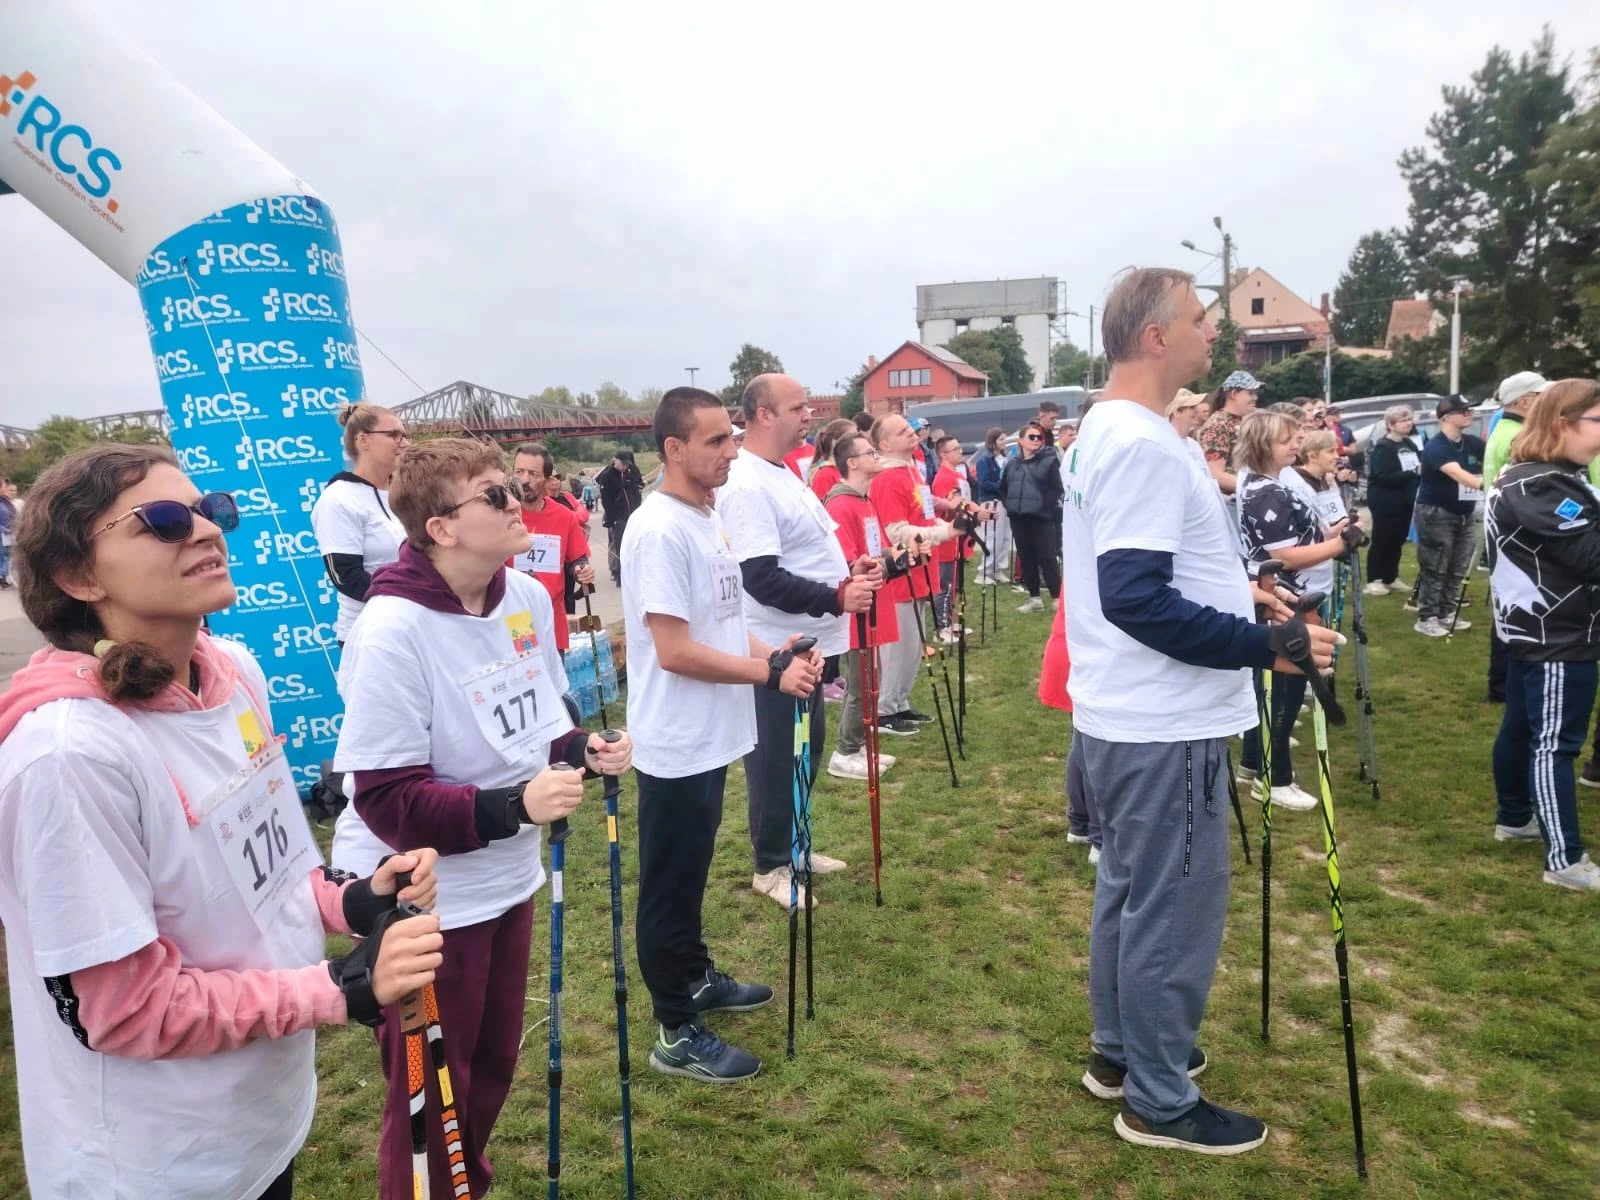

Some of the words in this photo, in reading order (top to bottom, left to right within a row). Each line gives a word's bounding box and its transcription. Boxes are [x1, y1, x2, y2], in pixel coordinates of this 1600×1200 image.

[218, 242, 289, 267] RCS.
[283, 292, 338, 318] RCS.
[237, 340, 307, 365] RCS.
[255, 435, 324, 461] RCS.
[526, 548, 547, 563] 47
[719, 575, 739, 602] 178
[267, 673, 315, 698] CS.
[493, 688, 538, 740] 177
[242, 806, 290, 892] 176
